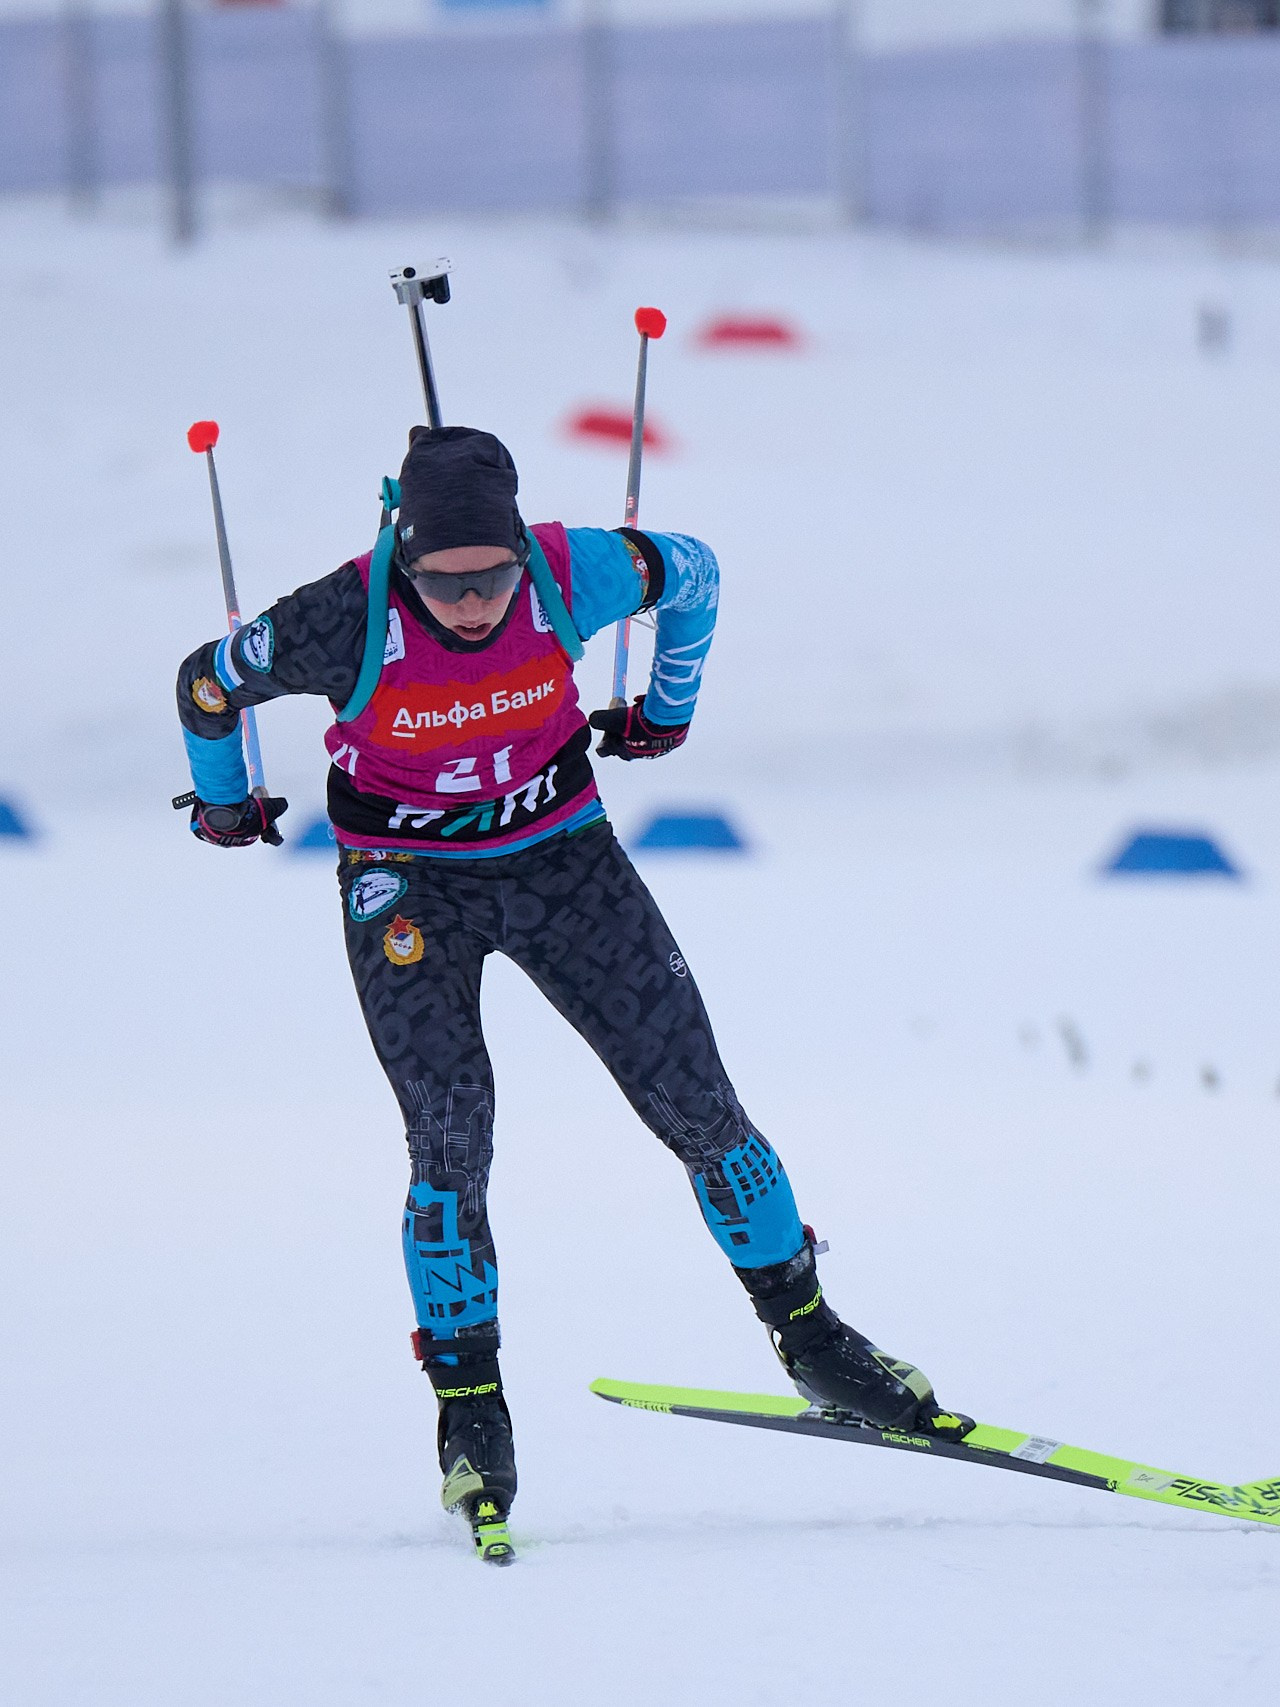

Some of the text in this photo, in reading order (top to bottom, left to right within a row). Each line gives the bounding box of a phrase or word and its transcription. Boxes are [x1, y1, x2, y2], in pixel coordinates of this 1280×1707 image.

[392, 678, 555, 729] Альфа Банк
[435, 745, 513, 794] 21
[387, 764, 558, 837] PARI
[881, 1432, 932, 1448] FISCHER
